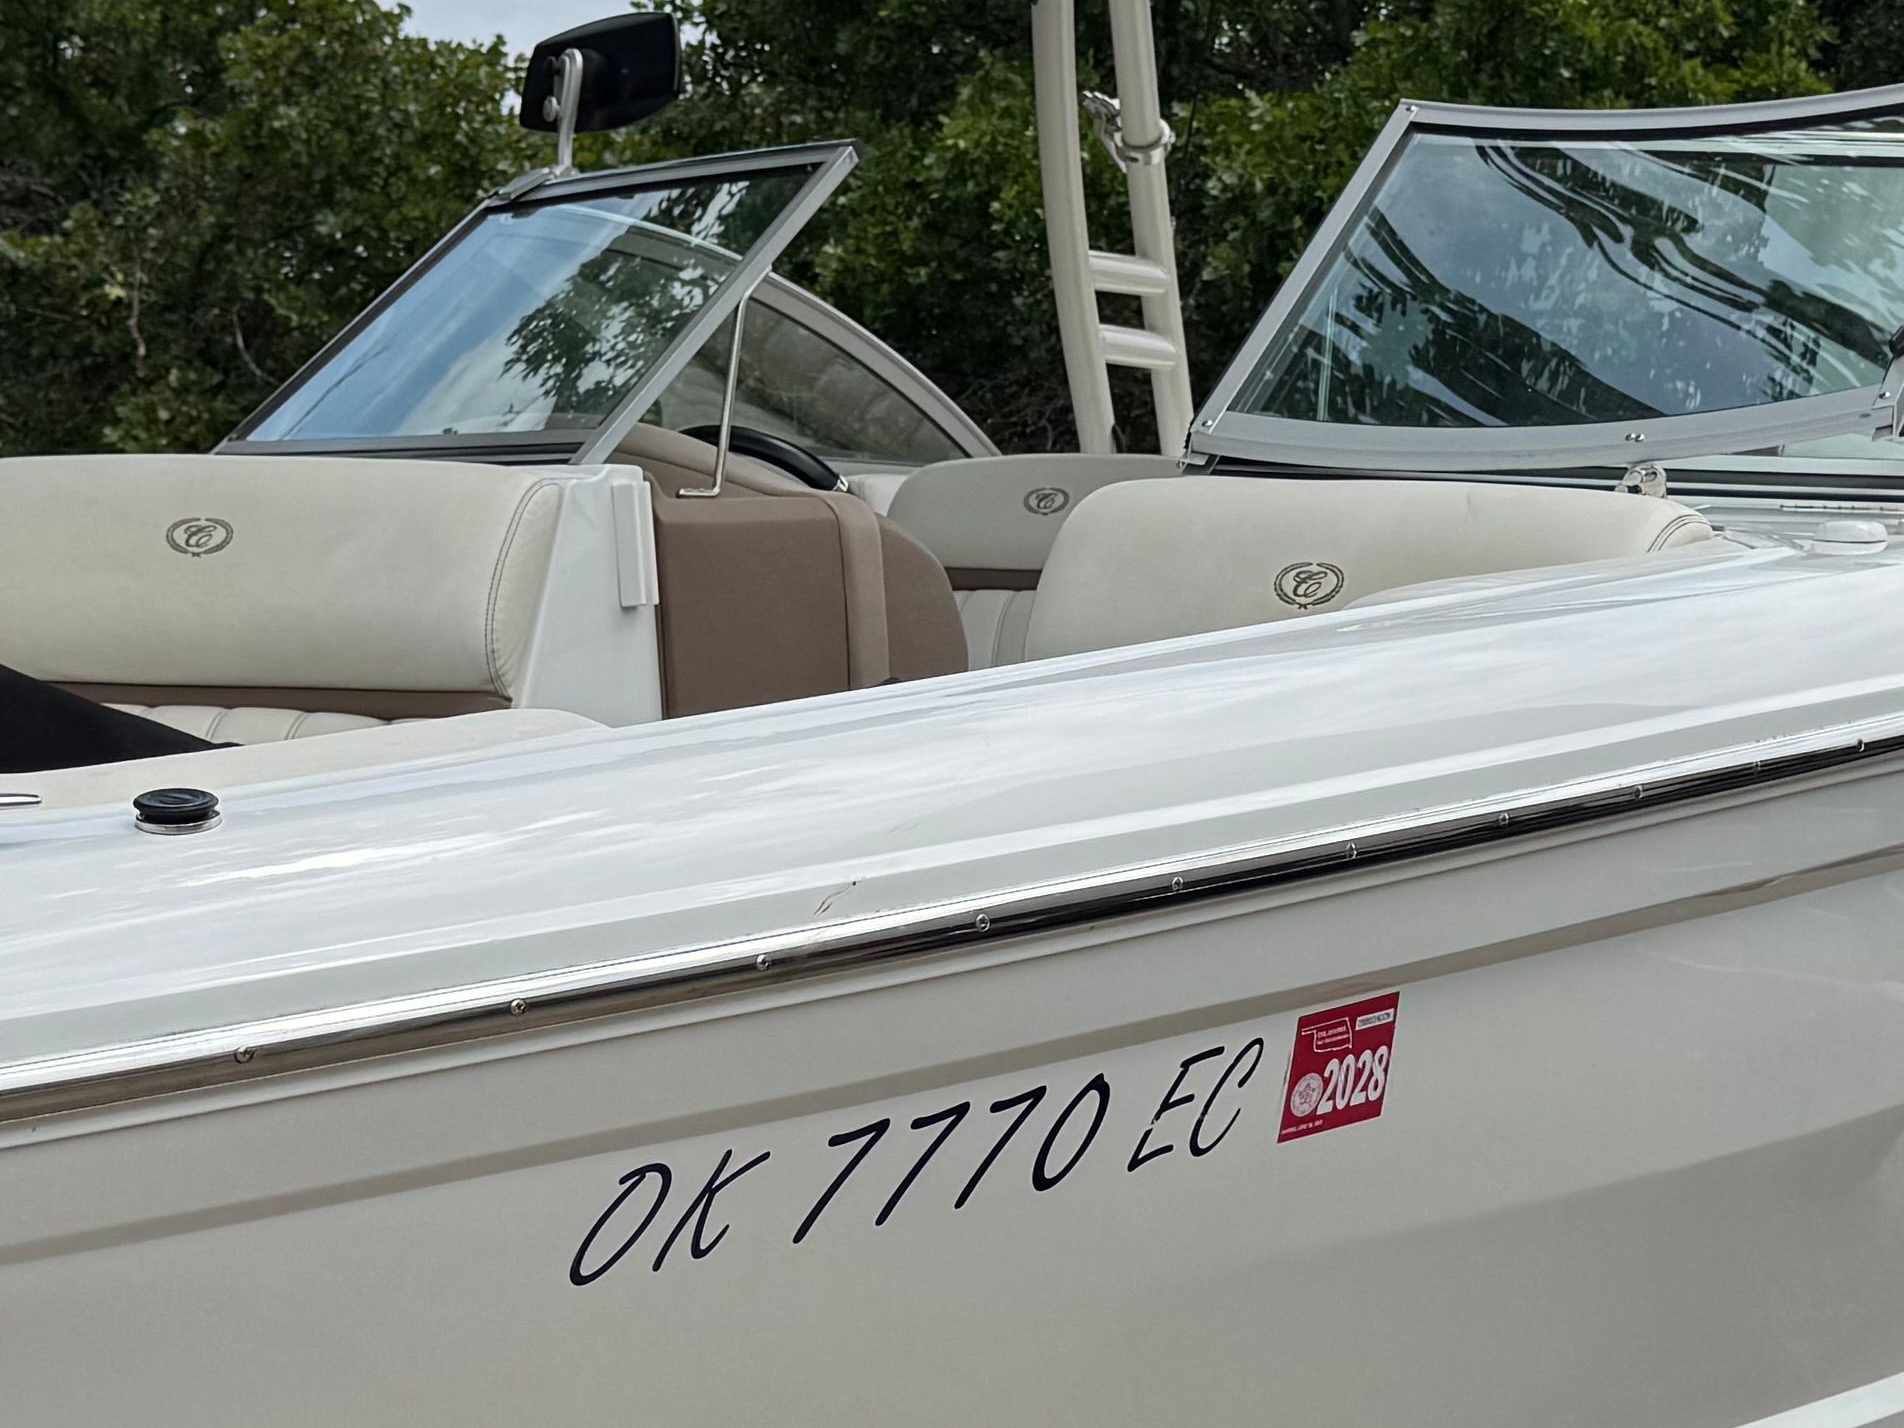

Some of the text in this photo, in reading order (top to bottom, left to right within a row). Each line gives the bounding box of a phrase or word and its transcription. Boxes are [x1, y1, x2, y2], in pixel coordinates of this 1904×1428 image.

[1316, 1044, 1389, 1116] 2028
[569, 1037, 1265, 1287] OK 7770 EC
